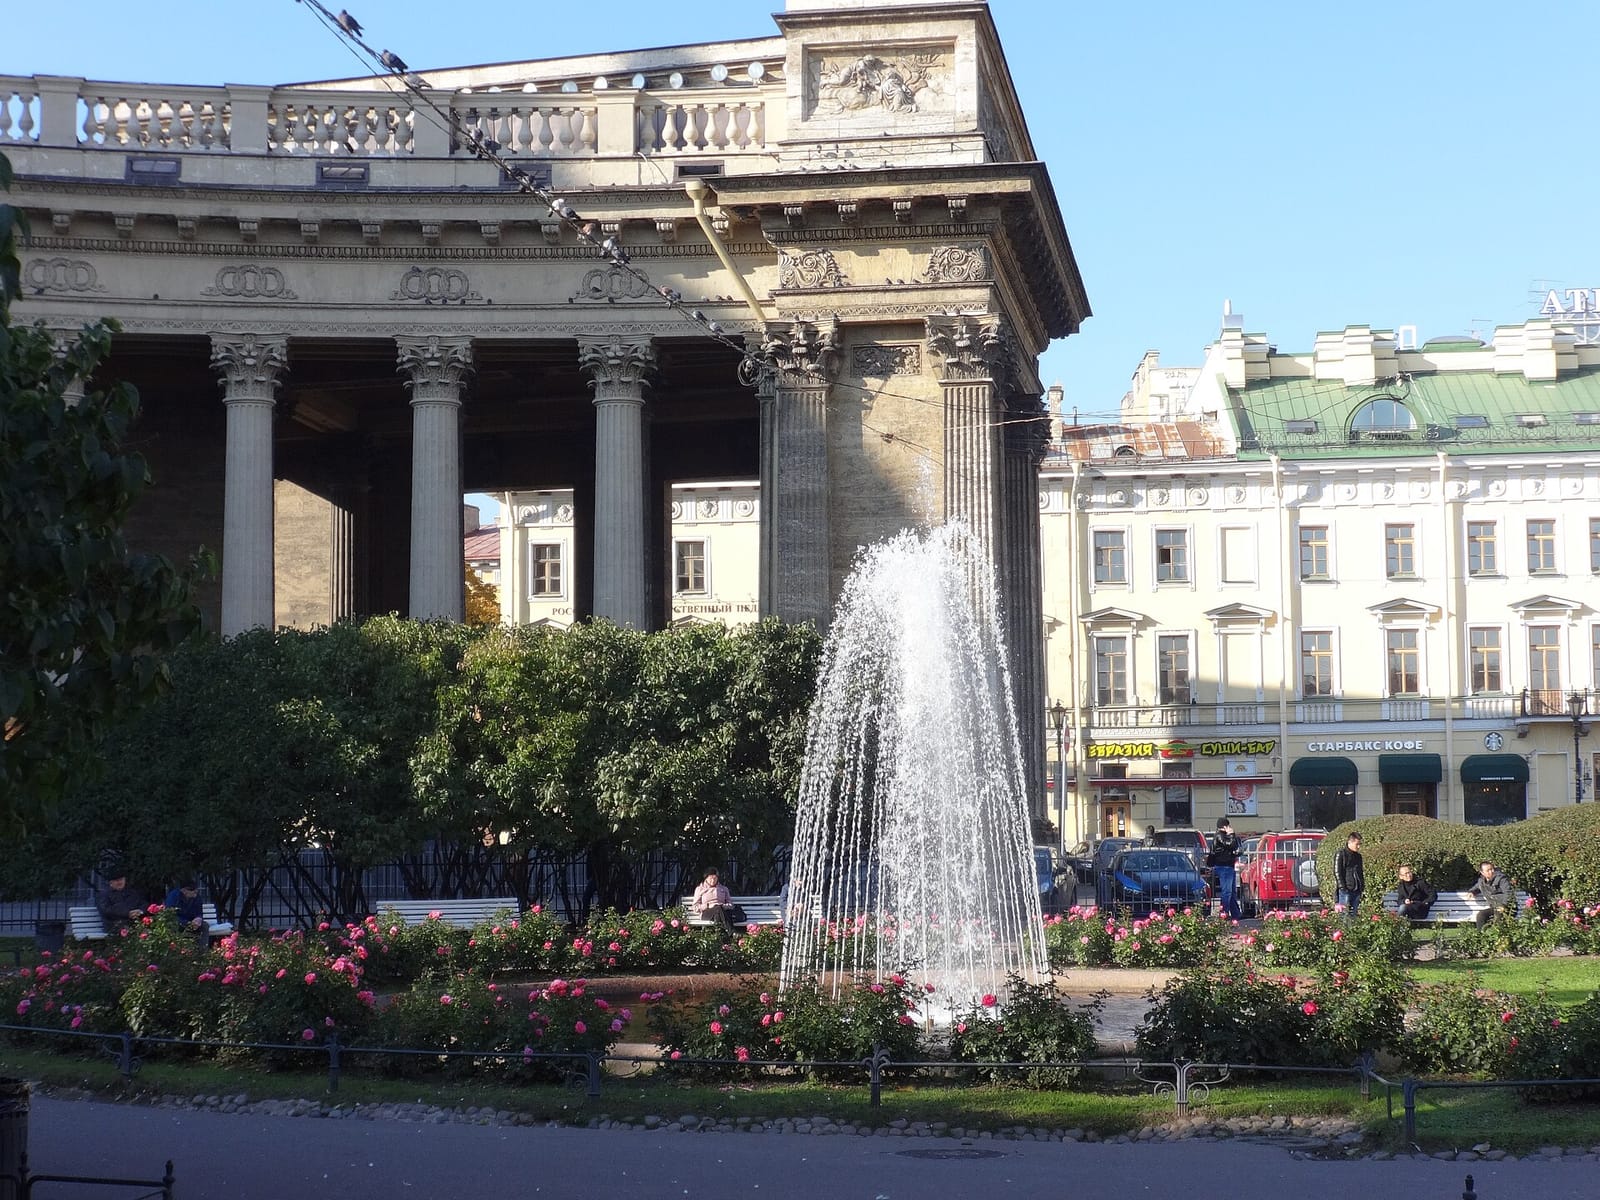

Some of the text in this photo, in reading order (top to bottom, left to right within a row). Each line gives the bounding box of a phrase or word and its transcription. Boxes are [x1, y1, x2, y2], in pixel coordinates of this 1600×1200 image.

[1087, 741, 1276, 758] ЕВРАЗИЯ СУШИ-БАР
[1308, 740, 1423, 752] СТАРБАКС КОФЕ
